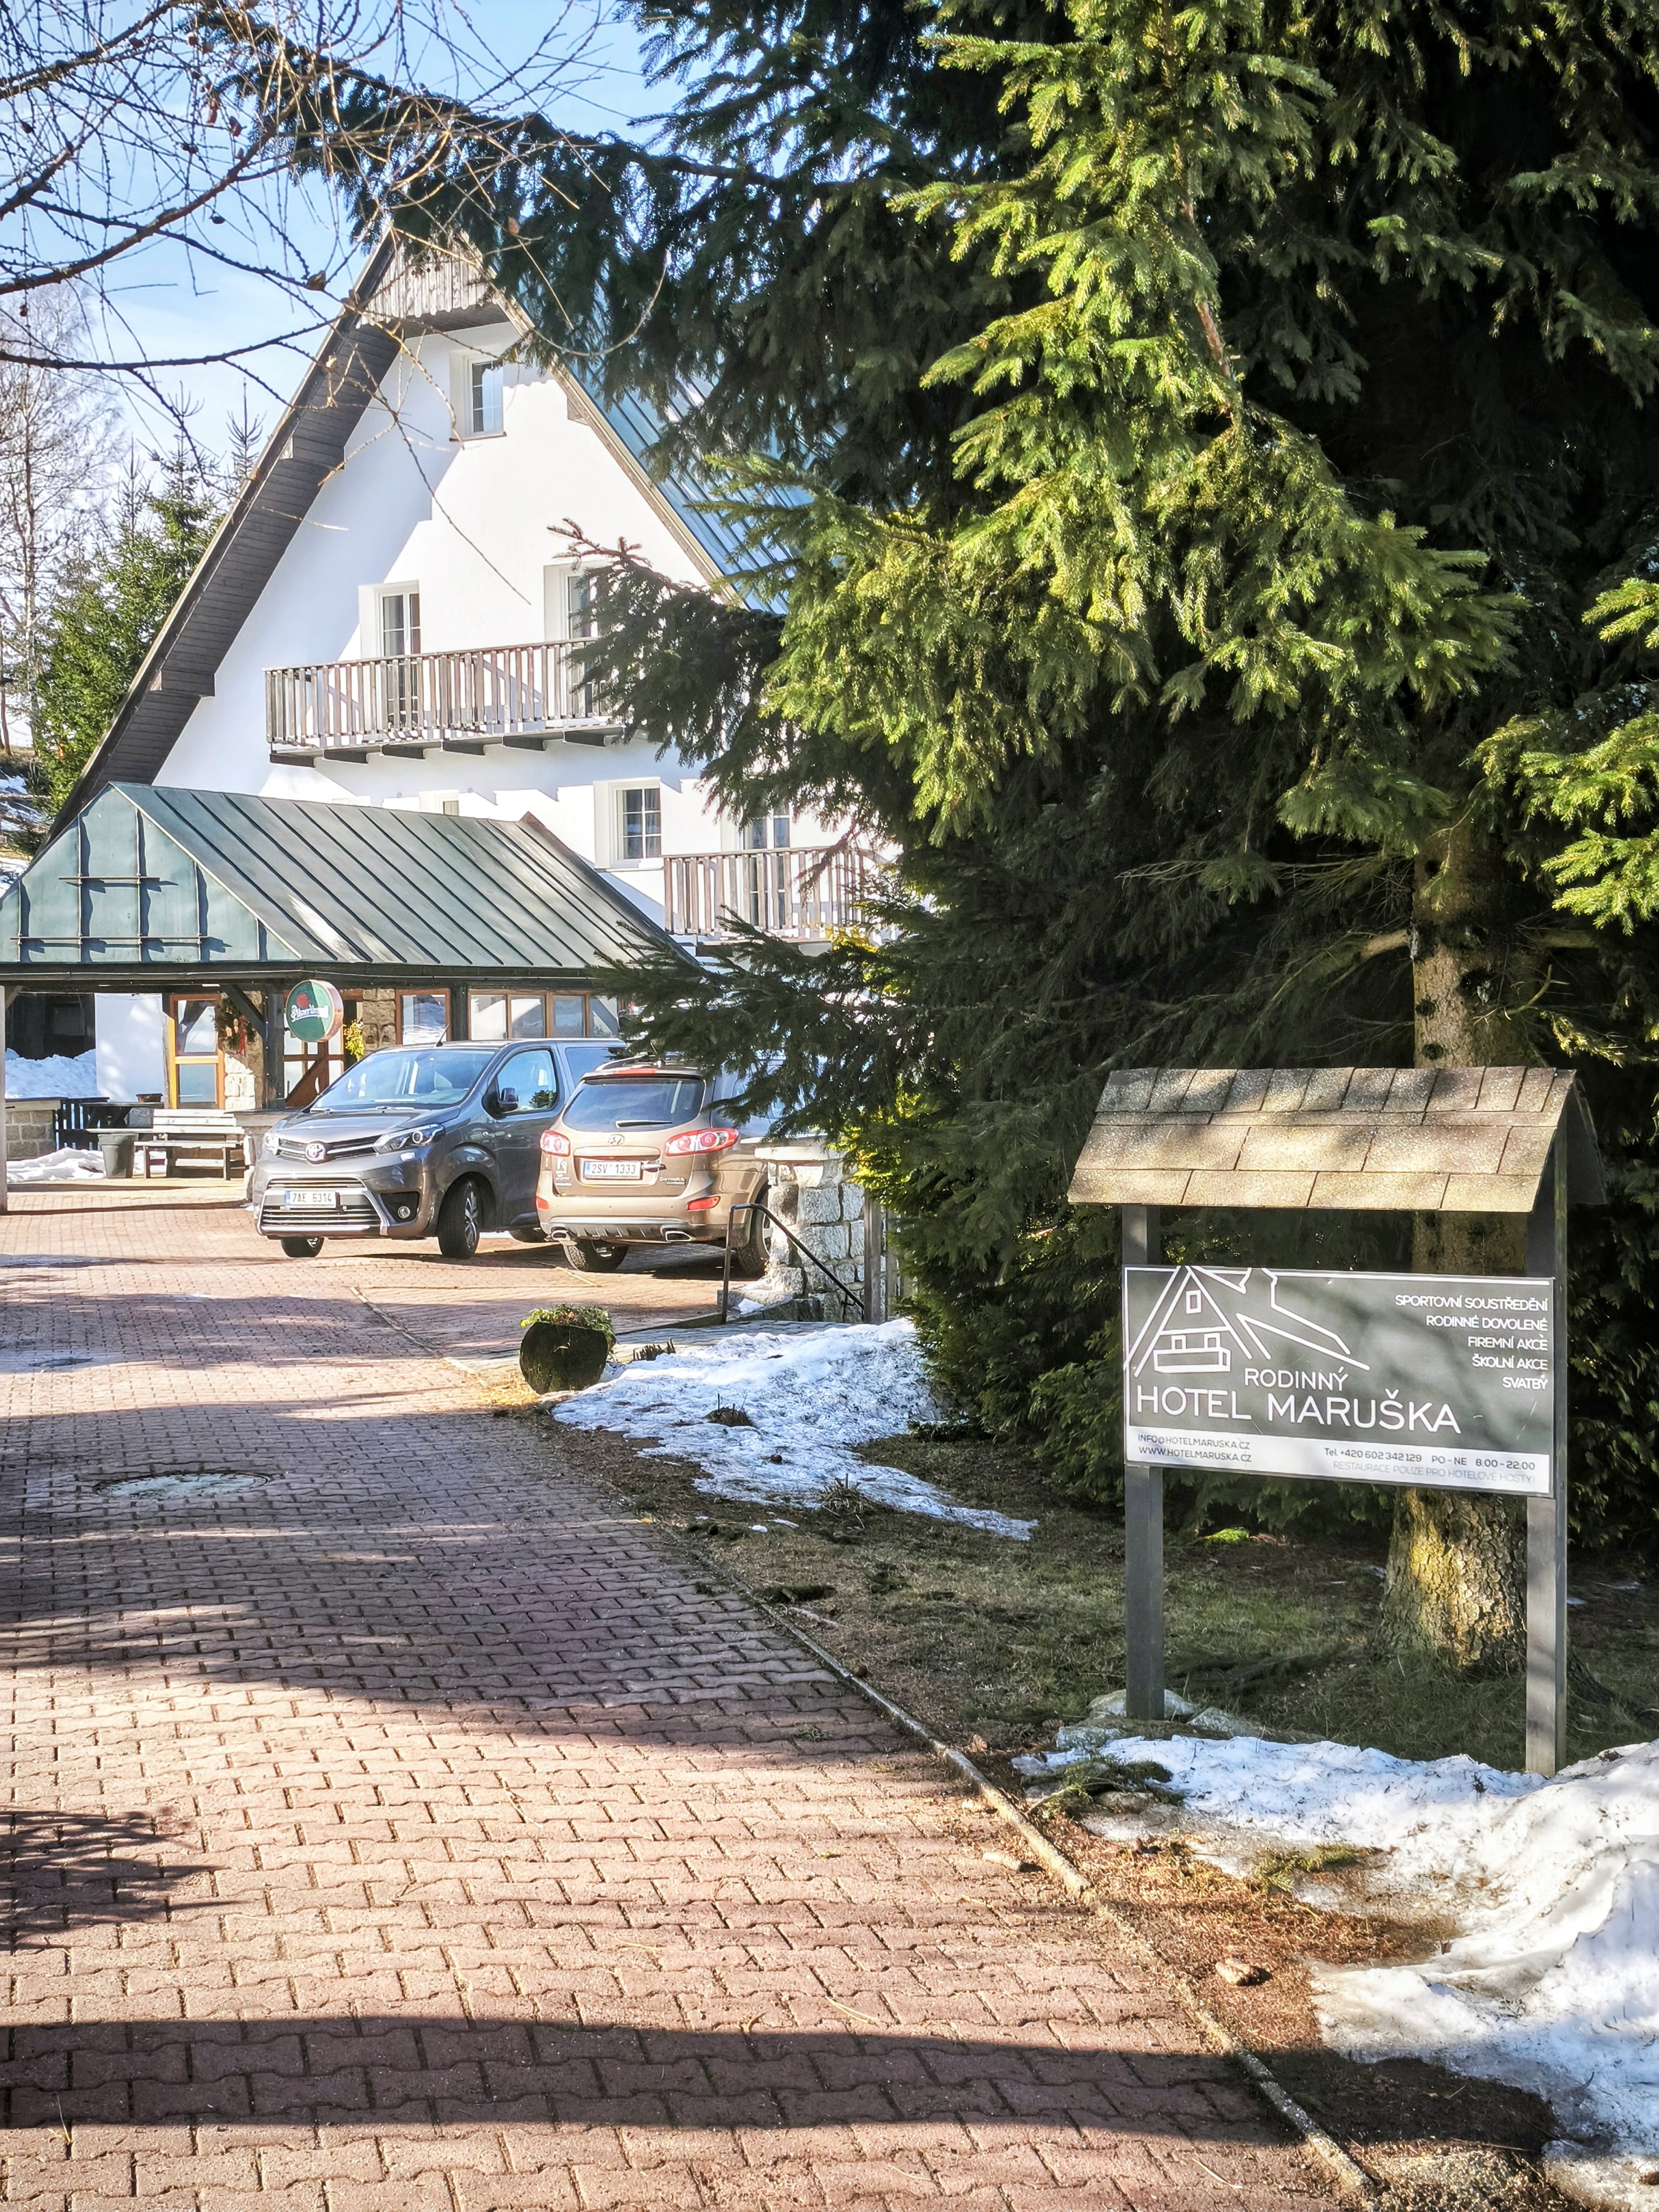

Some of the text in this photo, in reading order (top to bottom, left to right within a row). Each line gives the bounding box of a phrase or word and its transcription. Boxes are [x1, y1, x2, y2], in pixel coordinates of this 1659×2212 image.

[592, 1164, 636, 1174] 2SV 1333
[292, 1193, 332, 1202] 7AE 6314
[1395, 1294, 1548, 1311] SPORTOVNÍ SOUSTŘEDĚNÍ
[1426, 1314, 1548, 1331] RODINNÉ DOVOLENÉ
[1468, 1336, 1548, 1351] FIREMNÍ AKCE
[1472, 1353, 1548, 1371] ŠKOLNÍ AKCE
[1244, 1366, 1349, 1392] RODINNÝ
[1502, 1377, 1548, 1391] SVATBY
[1137, 1385, 1462, 1434] HOTEL MARUŠKA
[1333, 1461, 1391, 1473] RESTAURACE
[1393, 1465, 1424, 1476] POUZE
[1426, 1467, 1446, 1478] PRO
